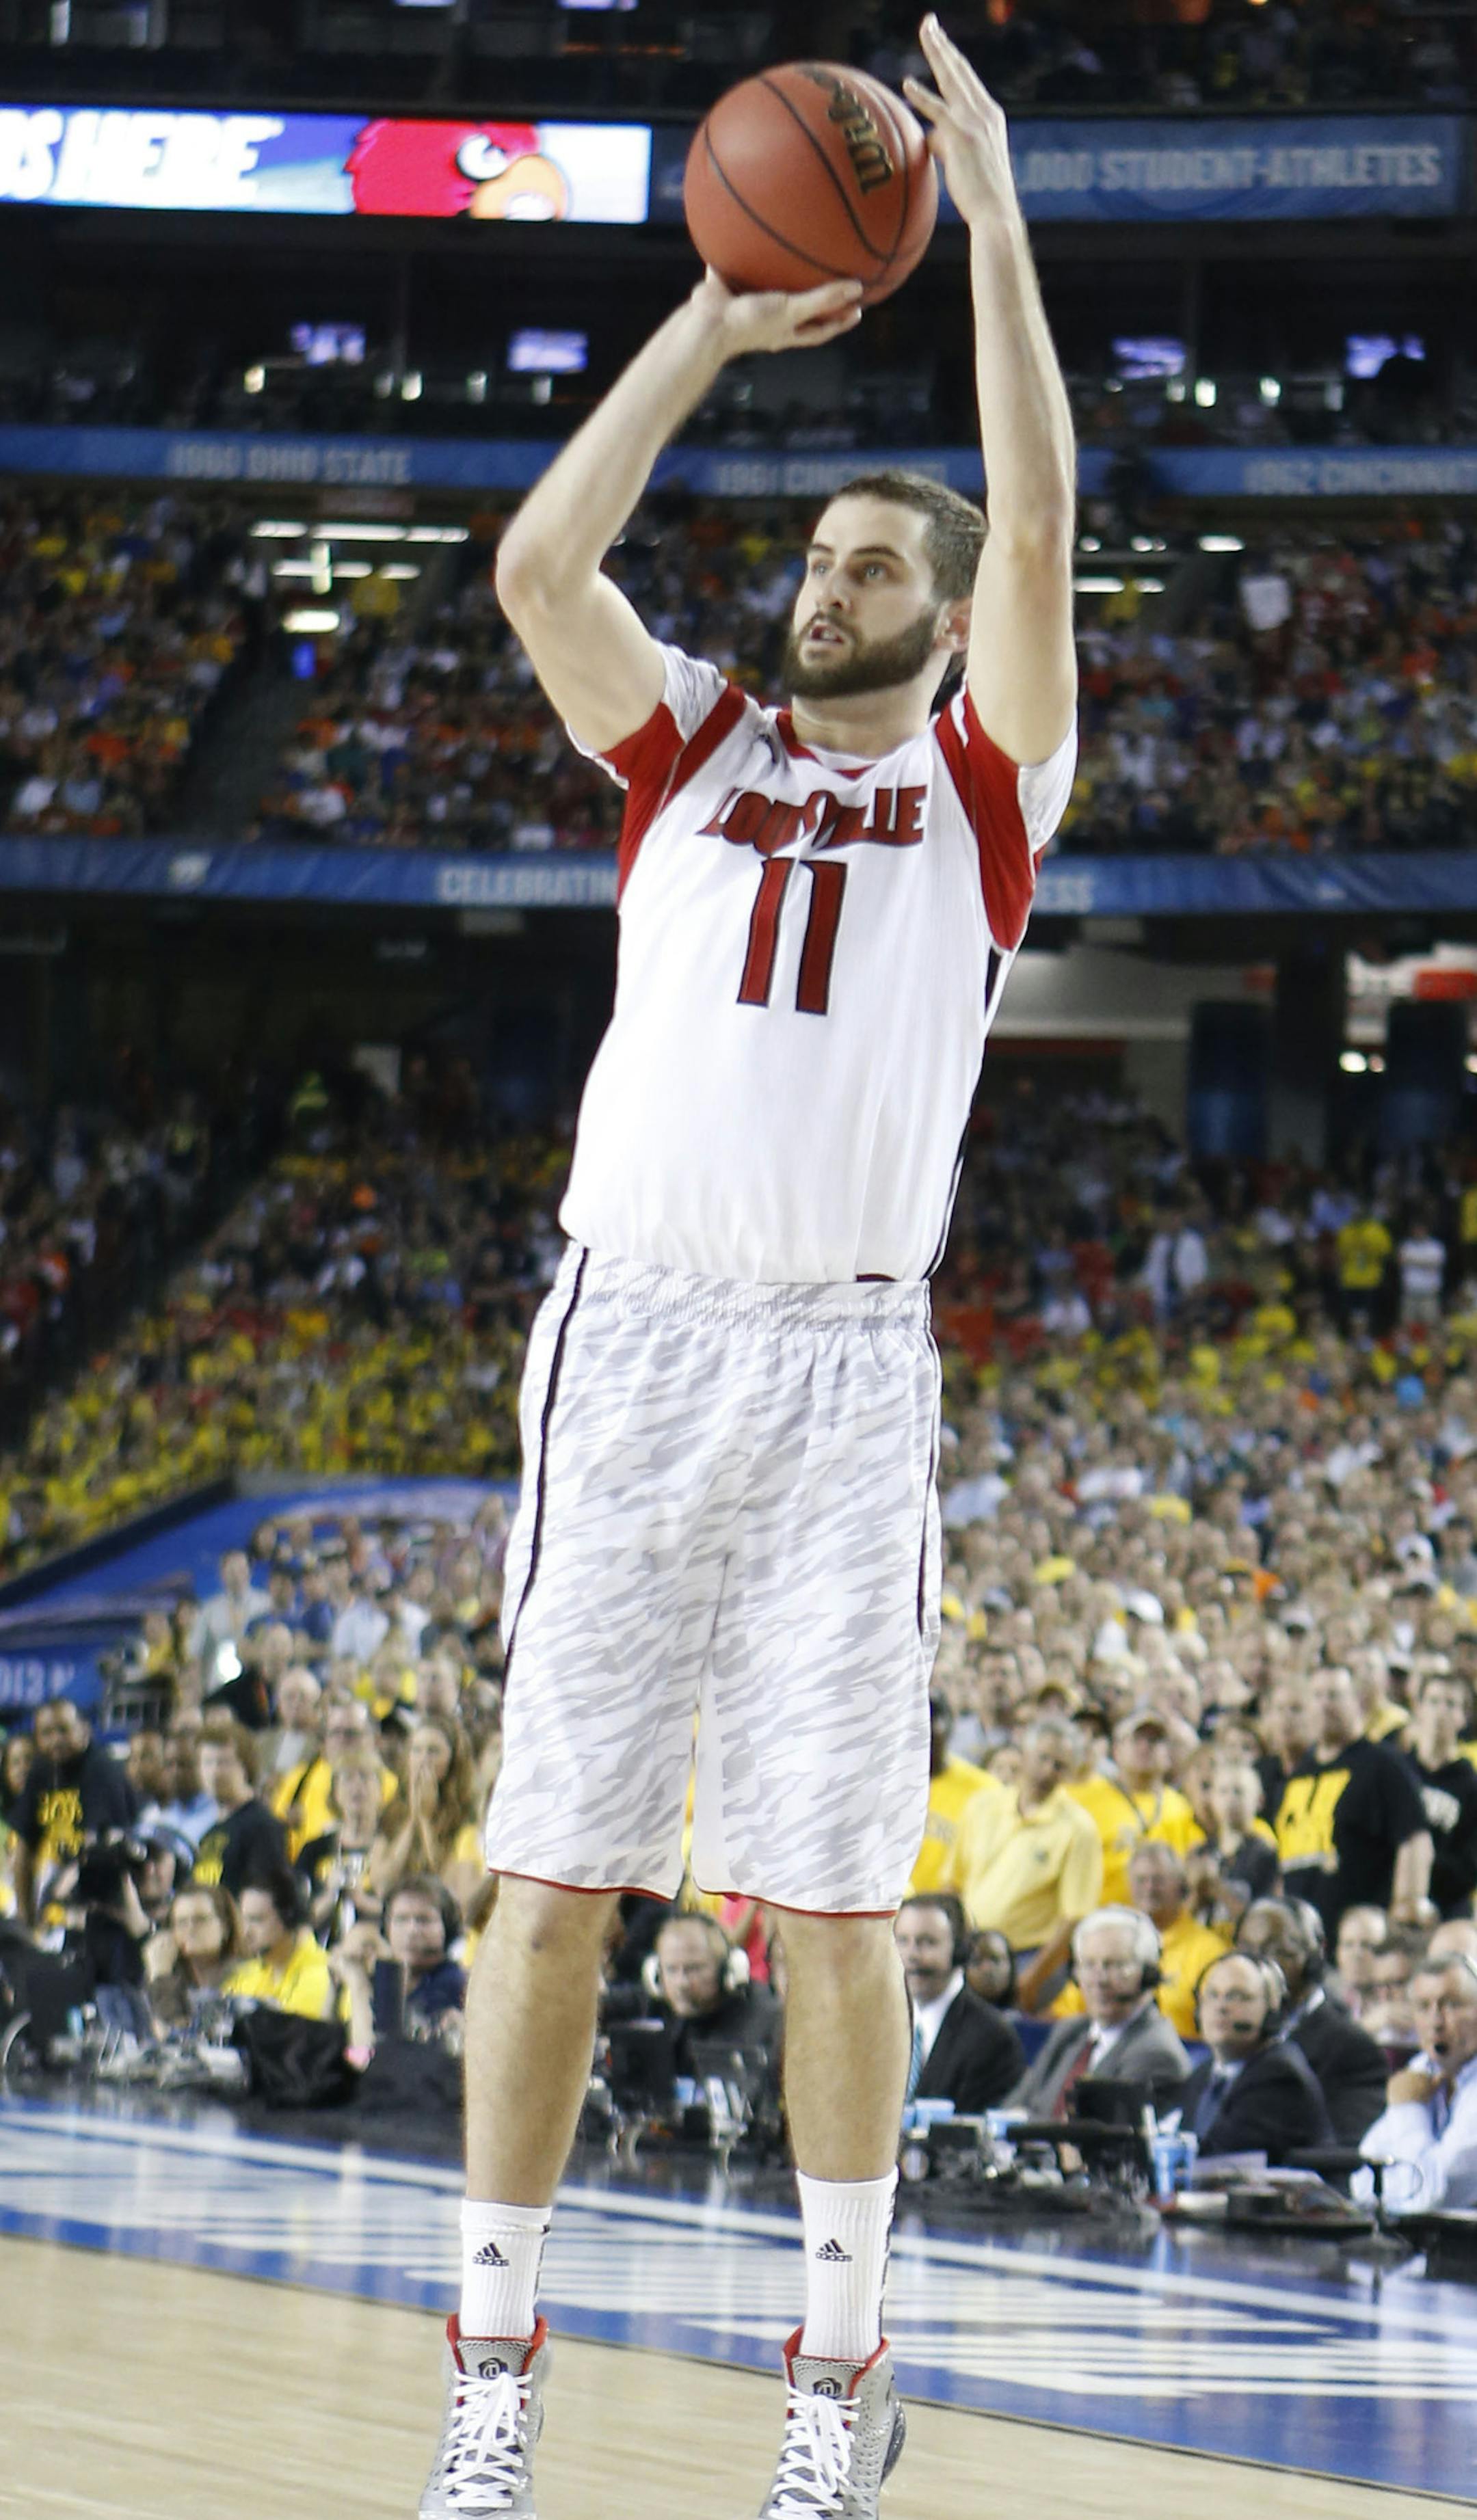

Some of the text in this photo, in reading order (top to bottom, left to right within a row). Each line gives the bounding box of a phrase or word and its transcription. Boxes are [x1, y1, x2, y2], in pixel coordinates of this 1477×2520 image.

[50, 110, 284, 206] HERE
[1099, 144, 1441, 191] STUDENT-ATHLETES
[323, 448, 410, 484] STATE
[695, 785, 927, 859] LOULLE
[736, 857, 847, 1015] 11
[472, 2255, 509, 2267] adidas
[814, 2251, 853, 2263] adidas
